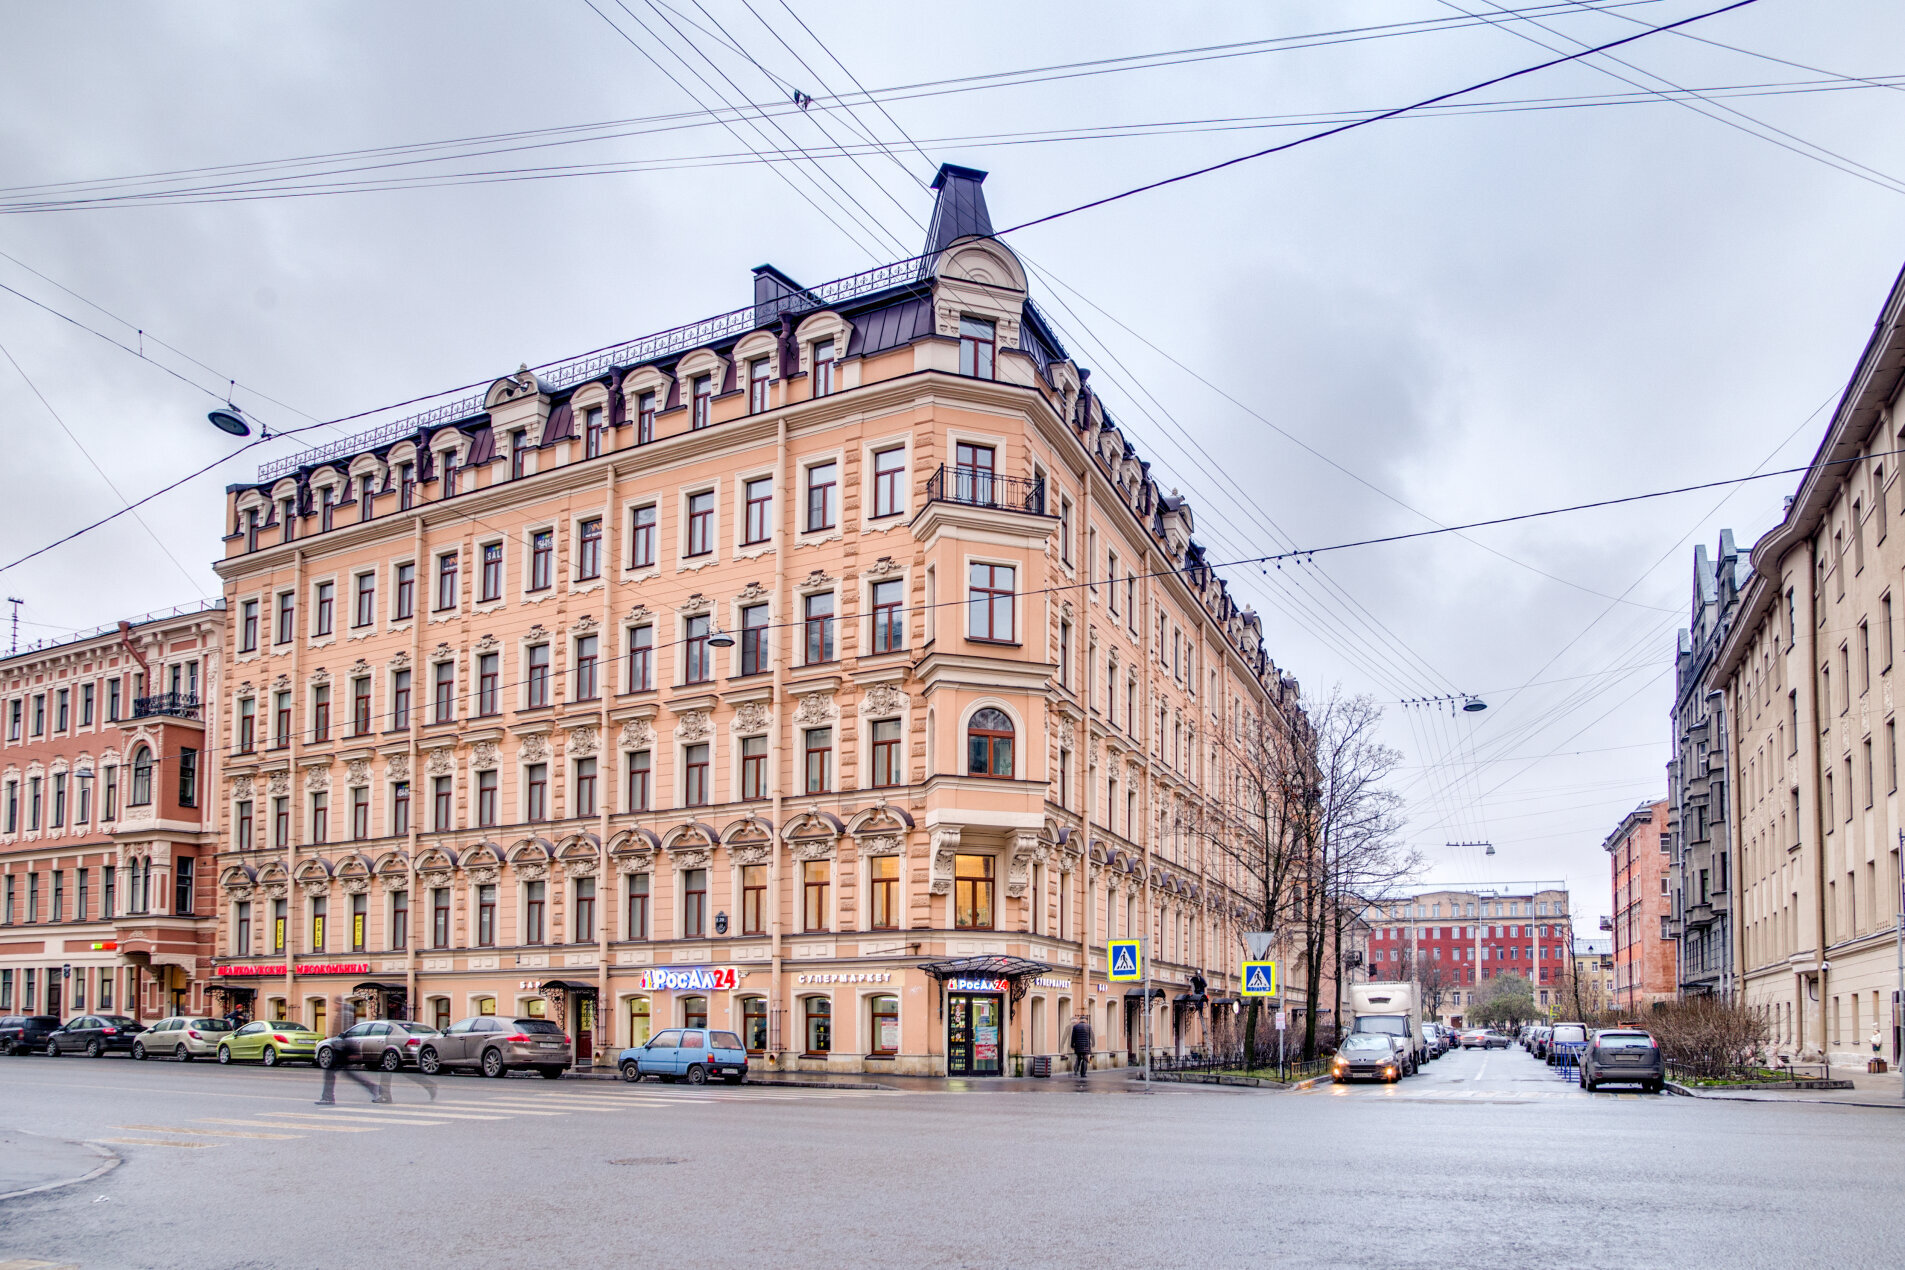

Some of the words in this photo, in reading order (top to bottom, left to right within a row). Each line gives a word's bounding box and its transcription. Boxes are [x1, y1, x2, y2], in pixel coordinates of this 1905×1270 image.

[487, 550, 501, 561] SAL
[296, 963, 369, 974] МЯСОКОМБИНАТ
[798, 973, 891, 984] СУПЕРМАРКЕТ
[520, 981, 541, 989] БАР
